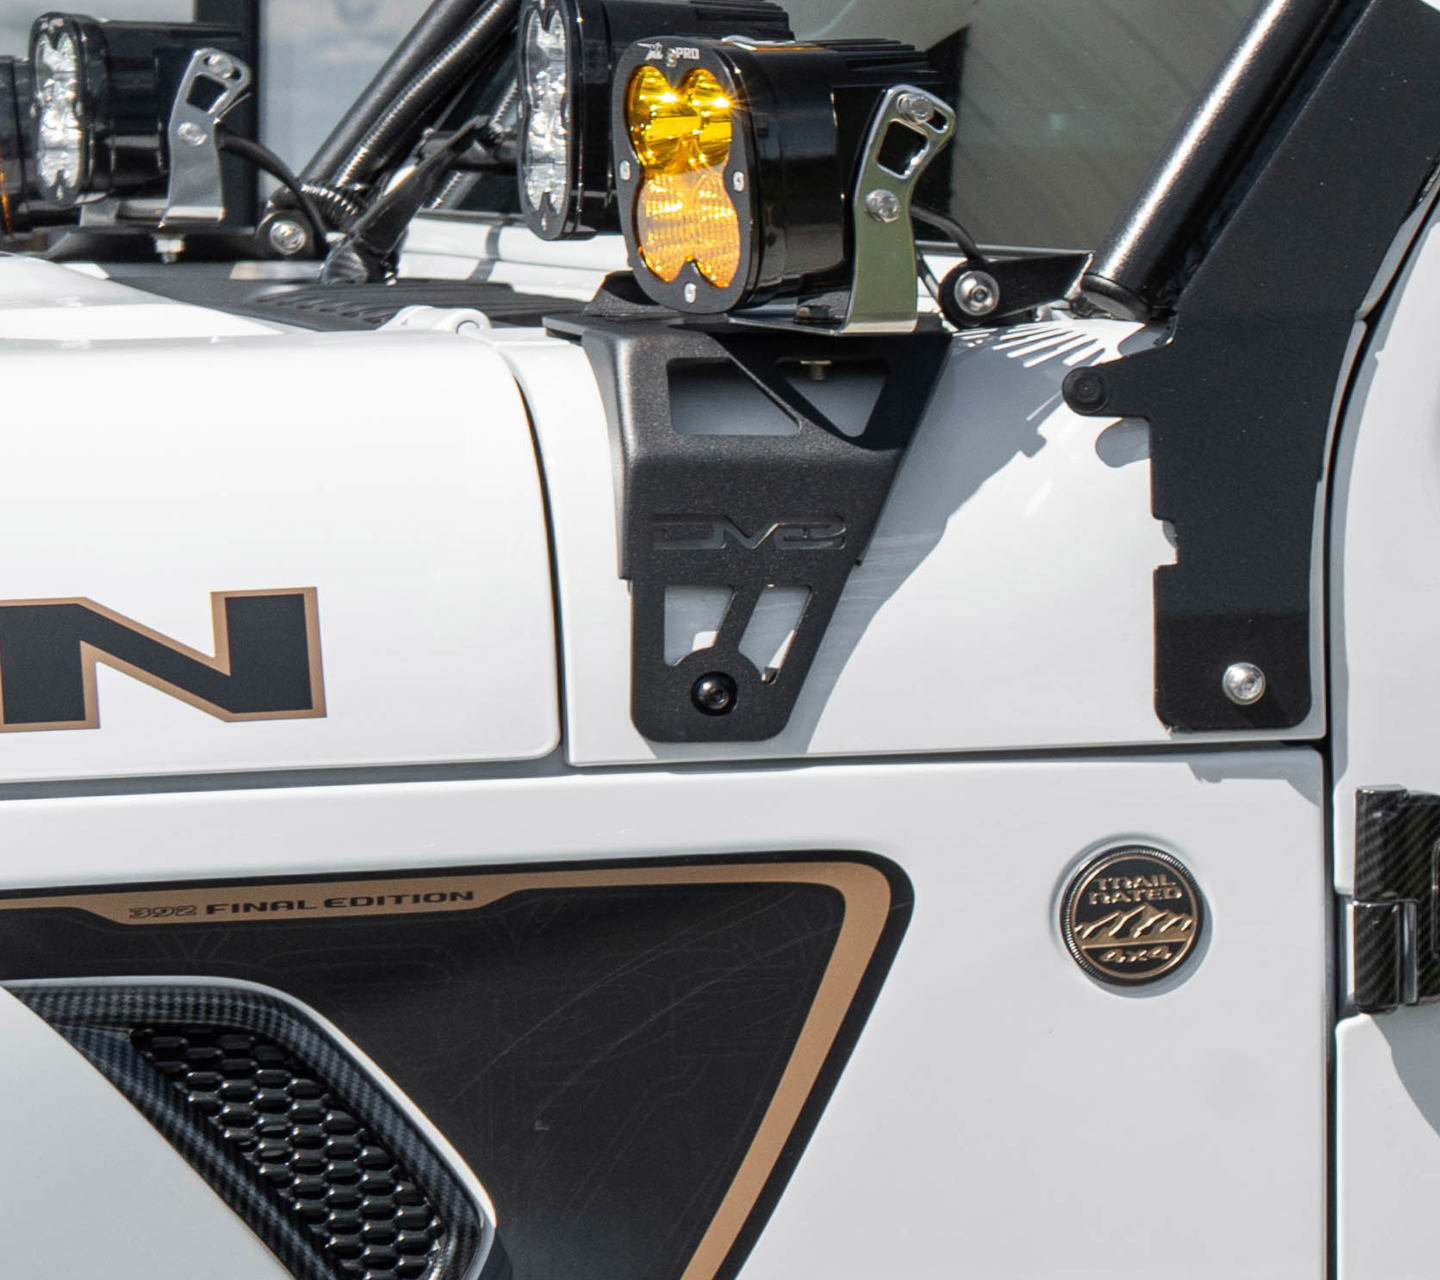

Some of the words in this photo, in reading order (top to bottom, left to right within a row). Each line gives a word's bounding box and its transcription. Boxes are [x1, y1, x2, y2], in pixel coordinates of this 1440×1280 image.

[675, 47, 700, 60] PRO
[1095, 873, 1177, 891] TRAIL
[129, 904, 198, 919] 392
[205, 899, 318, 915] FINAL
[323, 890, 475, 909] EDITION
[1088, 886, 1183, 905] RATED
